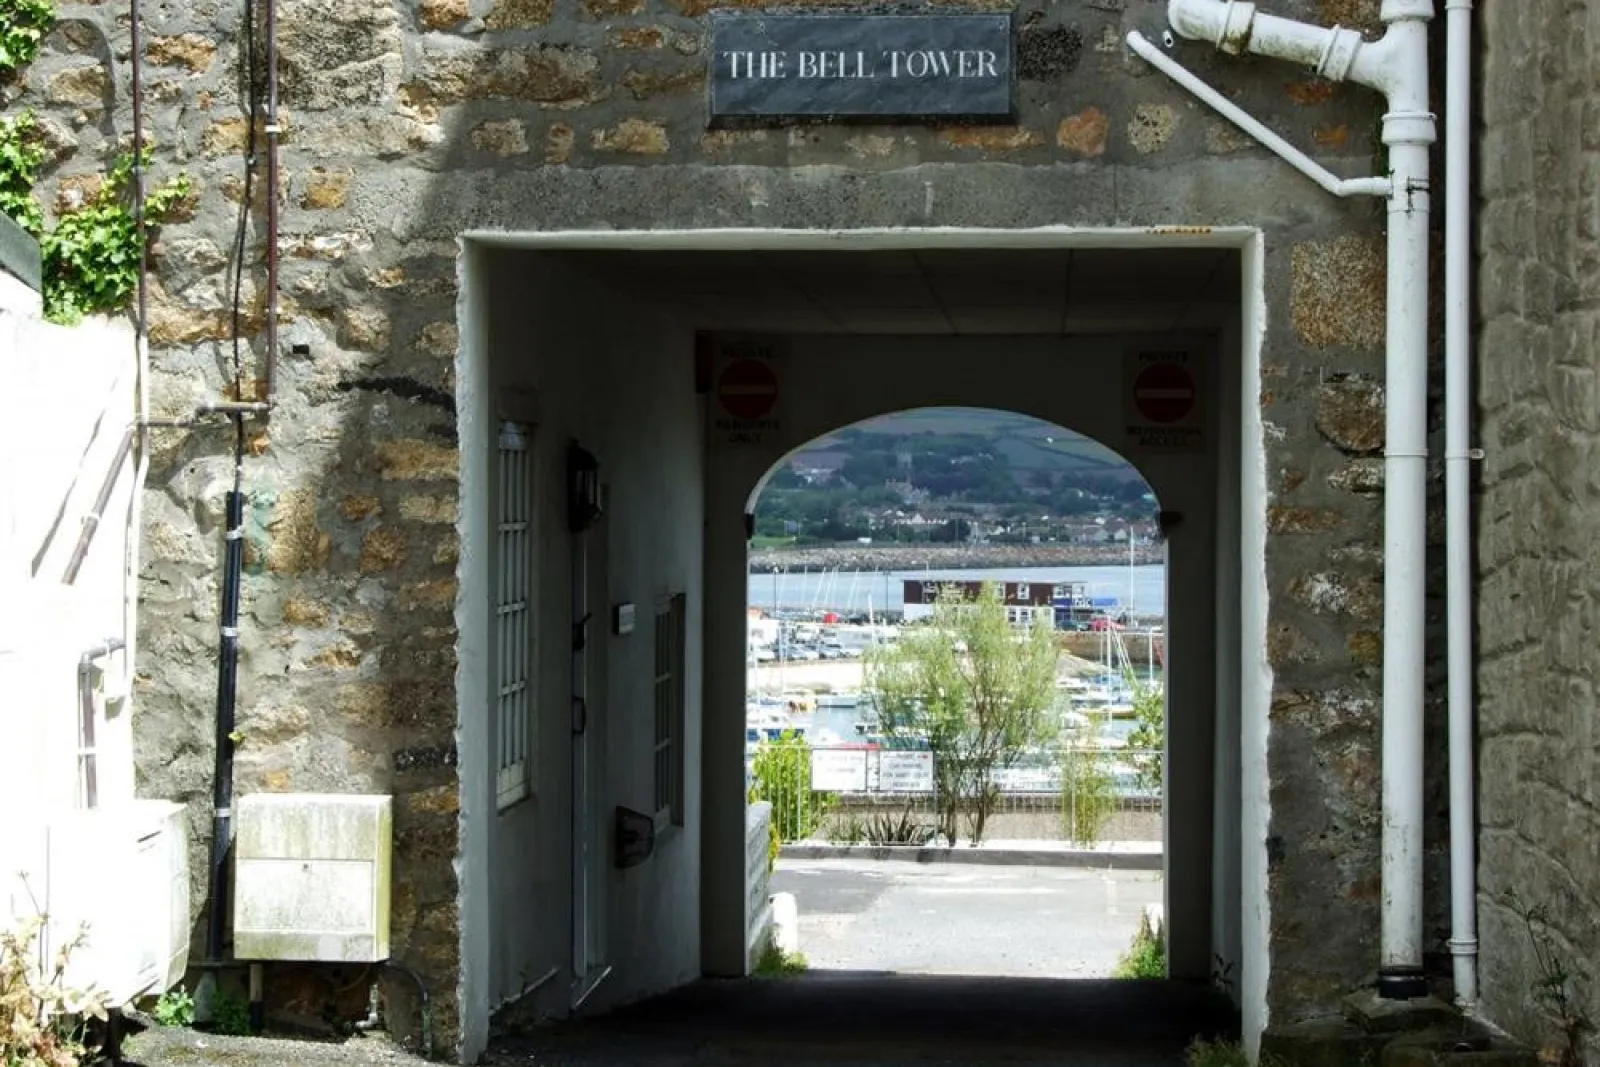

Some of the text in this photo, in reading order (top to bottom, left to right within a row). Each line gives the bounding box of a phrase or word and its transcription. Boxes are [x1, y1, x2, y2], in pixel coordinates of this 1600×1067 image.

[723, 50, 998, 79] THE BELL TOWER
[728, 432, 762, 445] ONLY
